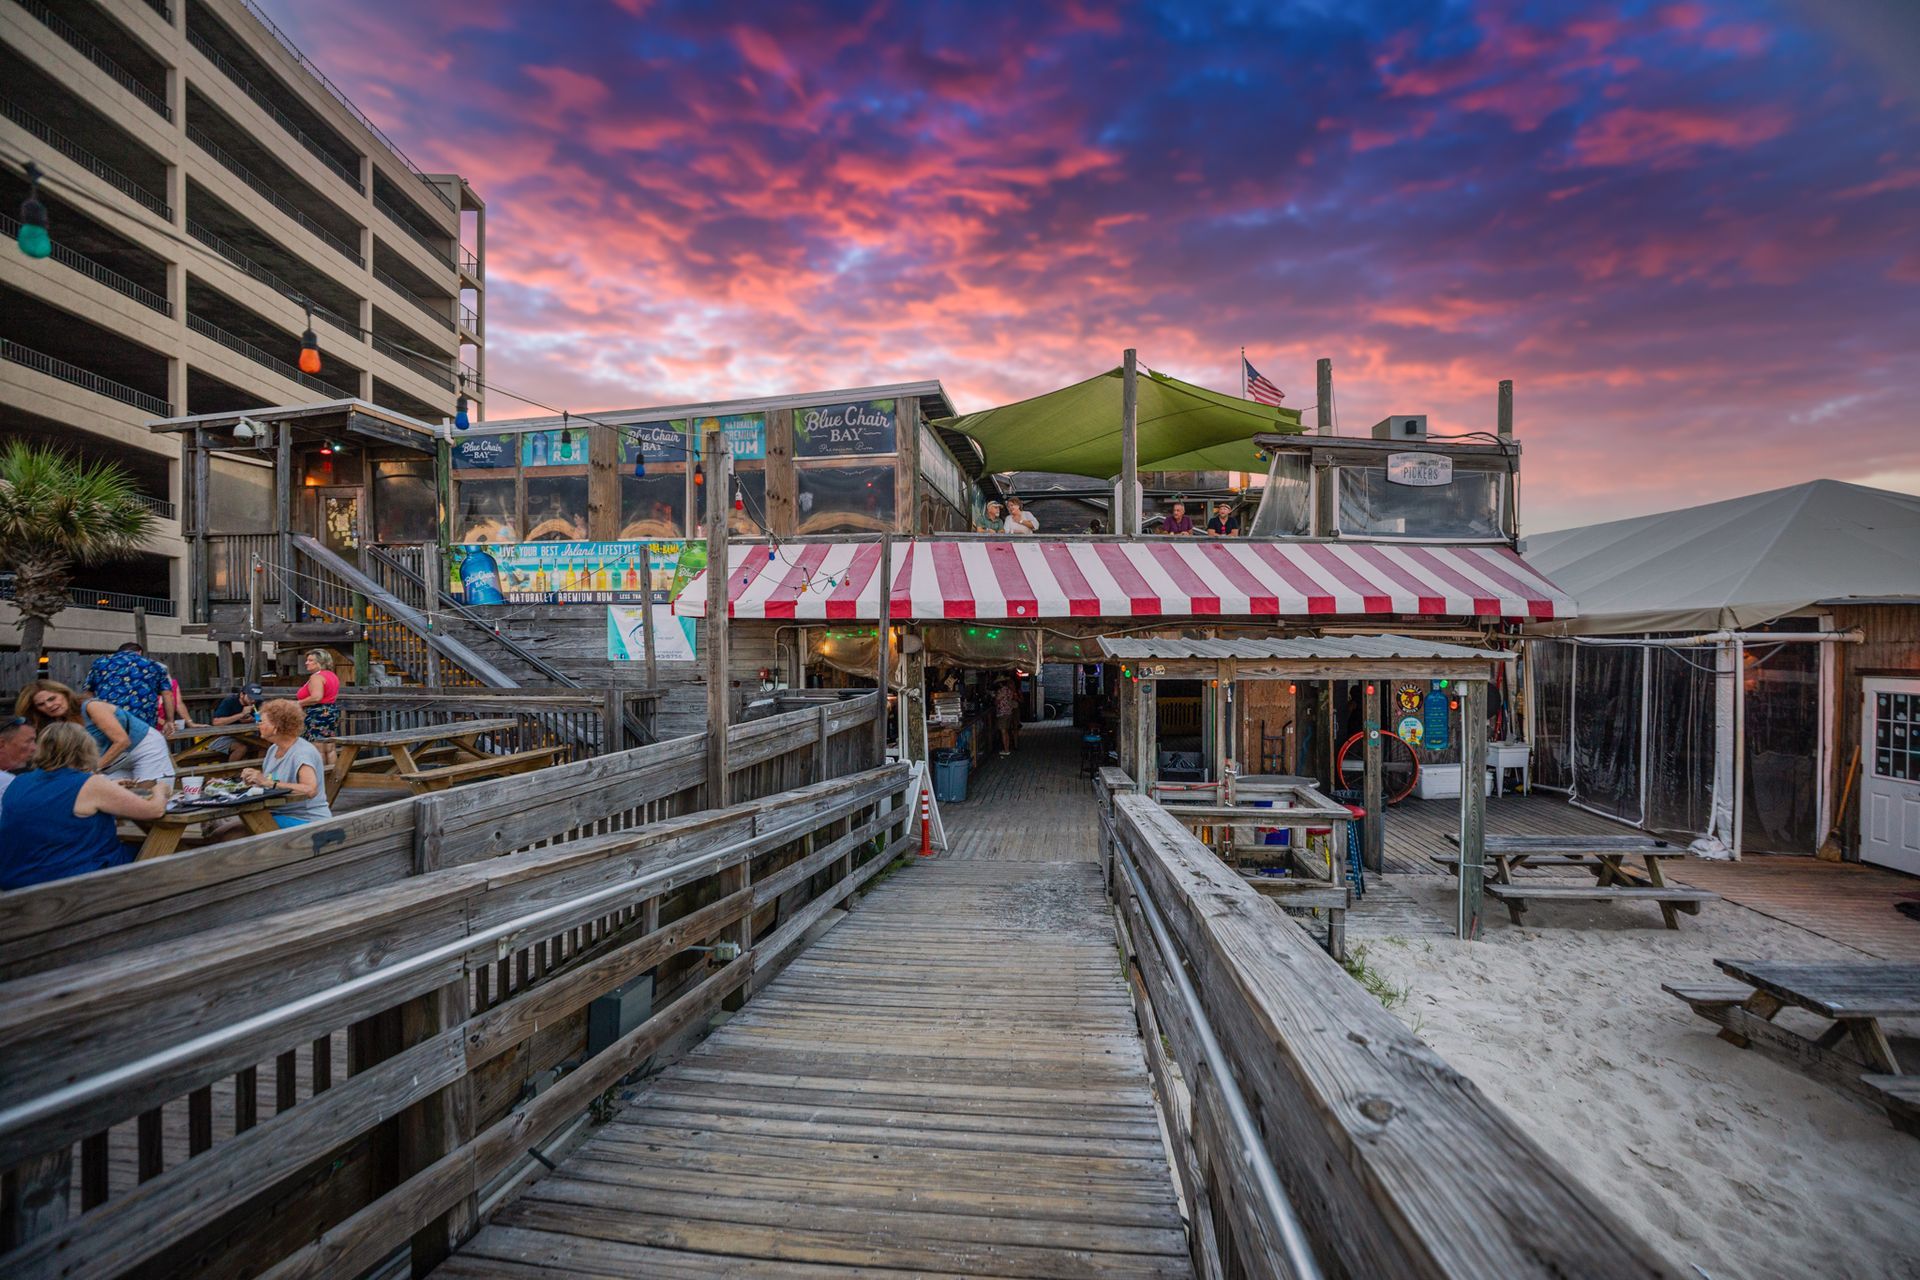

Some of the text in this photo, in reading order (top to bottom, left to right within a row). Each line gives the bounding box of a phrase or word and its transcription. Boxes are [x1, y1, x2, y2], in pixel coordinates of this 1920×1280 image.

[803, 405, 890, 432] Blue Chair
[651, 427, 681, 442] Chair
[830, 428, 863, 442] BAY
[462, 440, 503, 453] Blue Chair
[474, 451, 489, 459] BAY
[553, 450, 580, 461] RM
[1403, 466, 1438, 480] PICKERS
[499, 545, 515, 557] LIVE
[520, 545, 537, 557] YOUR
[541, 545, 559, 557] BEST
[561, 543, 596, 556] Island
[510, 592, 554, 603] NATURALLY
[596, 592, 613, 602] RUM
